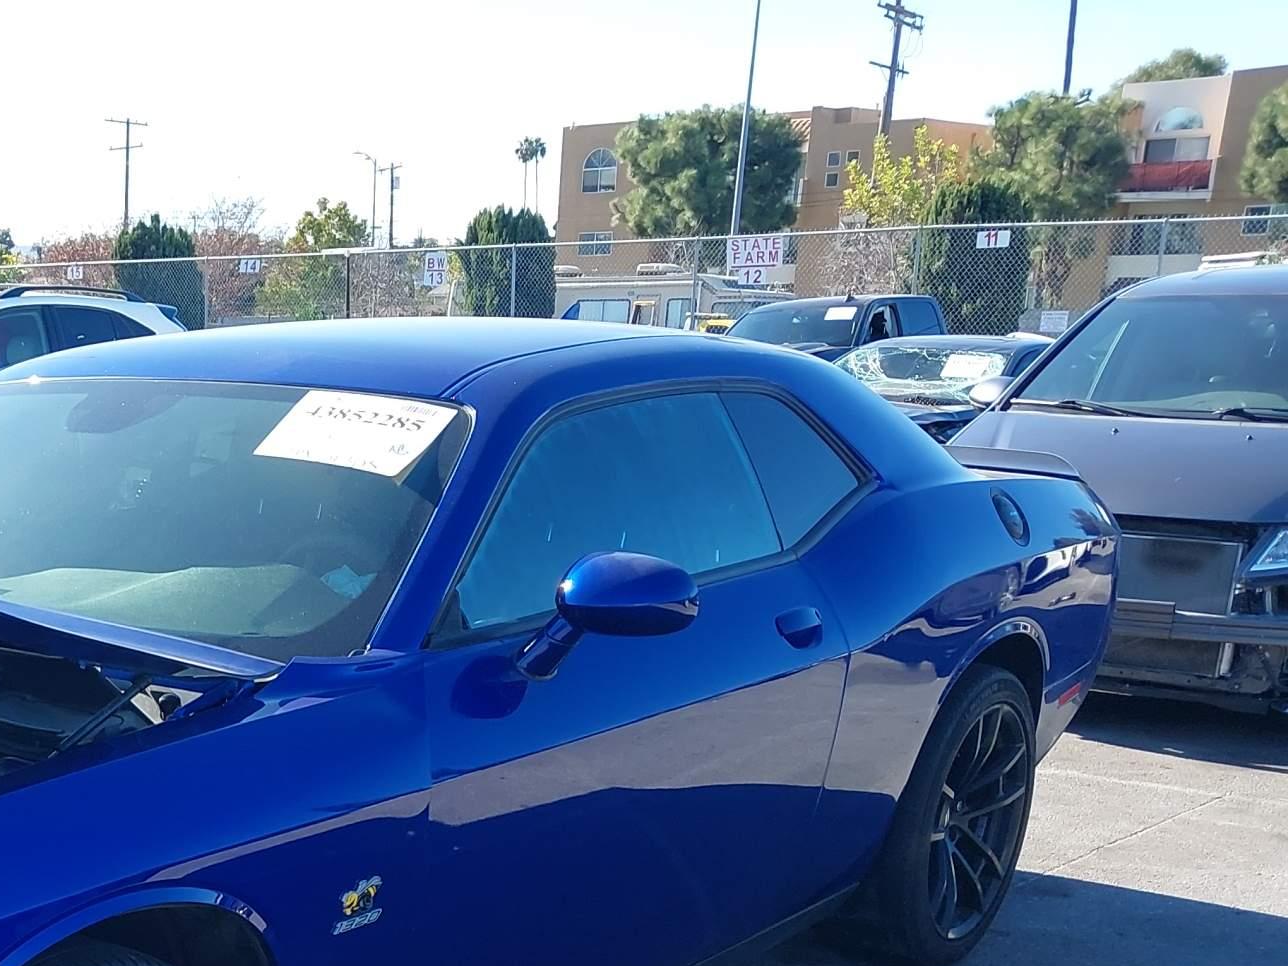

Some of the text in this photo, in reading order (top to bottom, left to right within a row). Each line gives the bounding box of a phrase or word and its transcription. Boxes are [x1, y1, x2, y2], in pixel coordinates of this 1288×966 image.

[731, 238, 782, 251] STATE
[984, 231, 999, 247] 11
[427, 257, 445, 269] BW
[733, 250, 779, 264] FARM
[70, 265, 81, 278] 15
[244, 260, 257, 272] 14
[428, 272, 444, 285] 13
[743, 269, 763, 284] 12
[305, 405, 426, 433] 43852285
[332, 908, 383, 936] 1320
